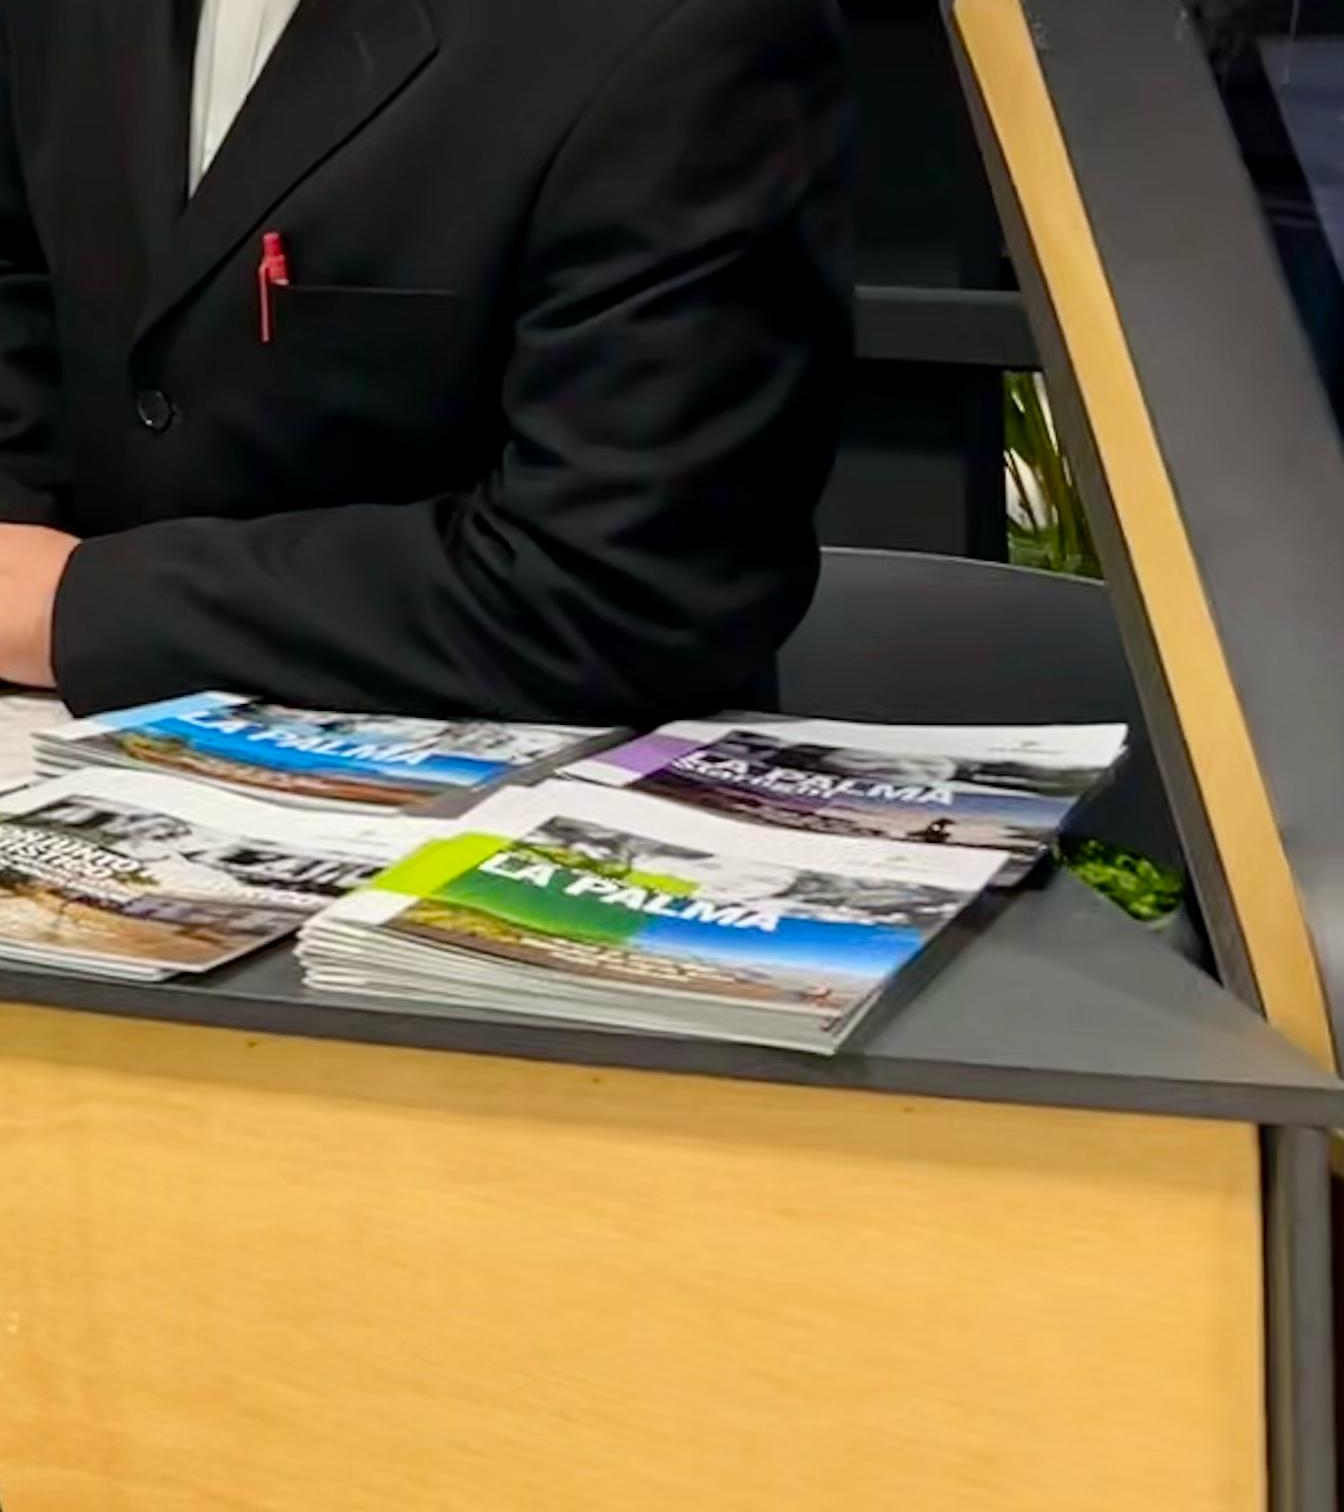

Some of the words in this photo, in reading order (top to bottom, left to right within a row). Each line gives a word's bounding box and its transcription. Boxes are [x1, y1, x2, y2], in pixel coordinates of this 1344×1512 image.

[248, 731, 432, 765] PALMA
[756, 767, 954, 805] PALMA
[478, 851, 561, 887] LA
[564, 868, 782, 932] PALMA
